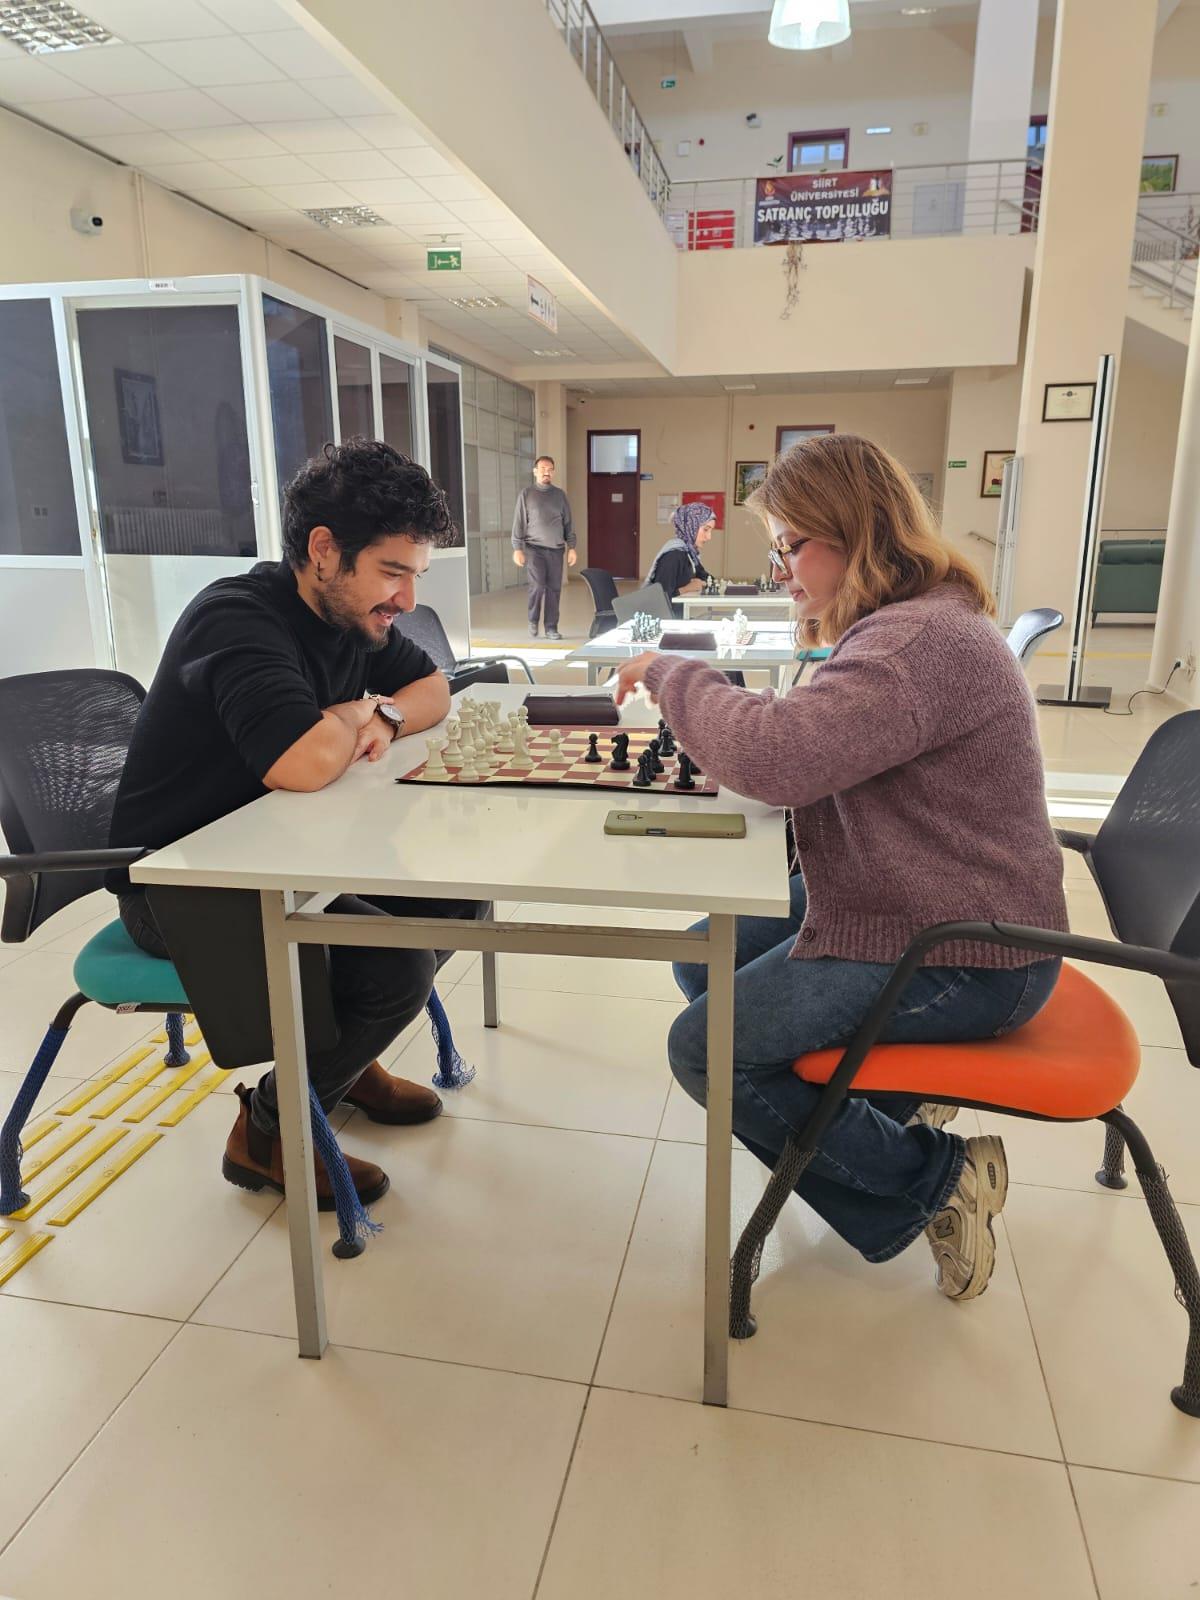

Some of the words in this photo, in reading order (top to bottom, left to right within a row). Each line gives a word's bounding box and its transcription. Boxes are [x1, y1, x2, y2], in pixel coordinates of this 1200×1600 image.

[812, 177, 838, 189] SİİRT
[790, 187, 859, 202] ÜNİVERSİTESİ
[757, 206, 812, 224] SATRANÇ
[815, 198, 889, 219] TOPLULUĞU
